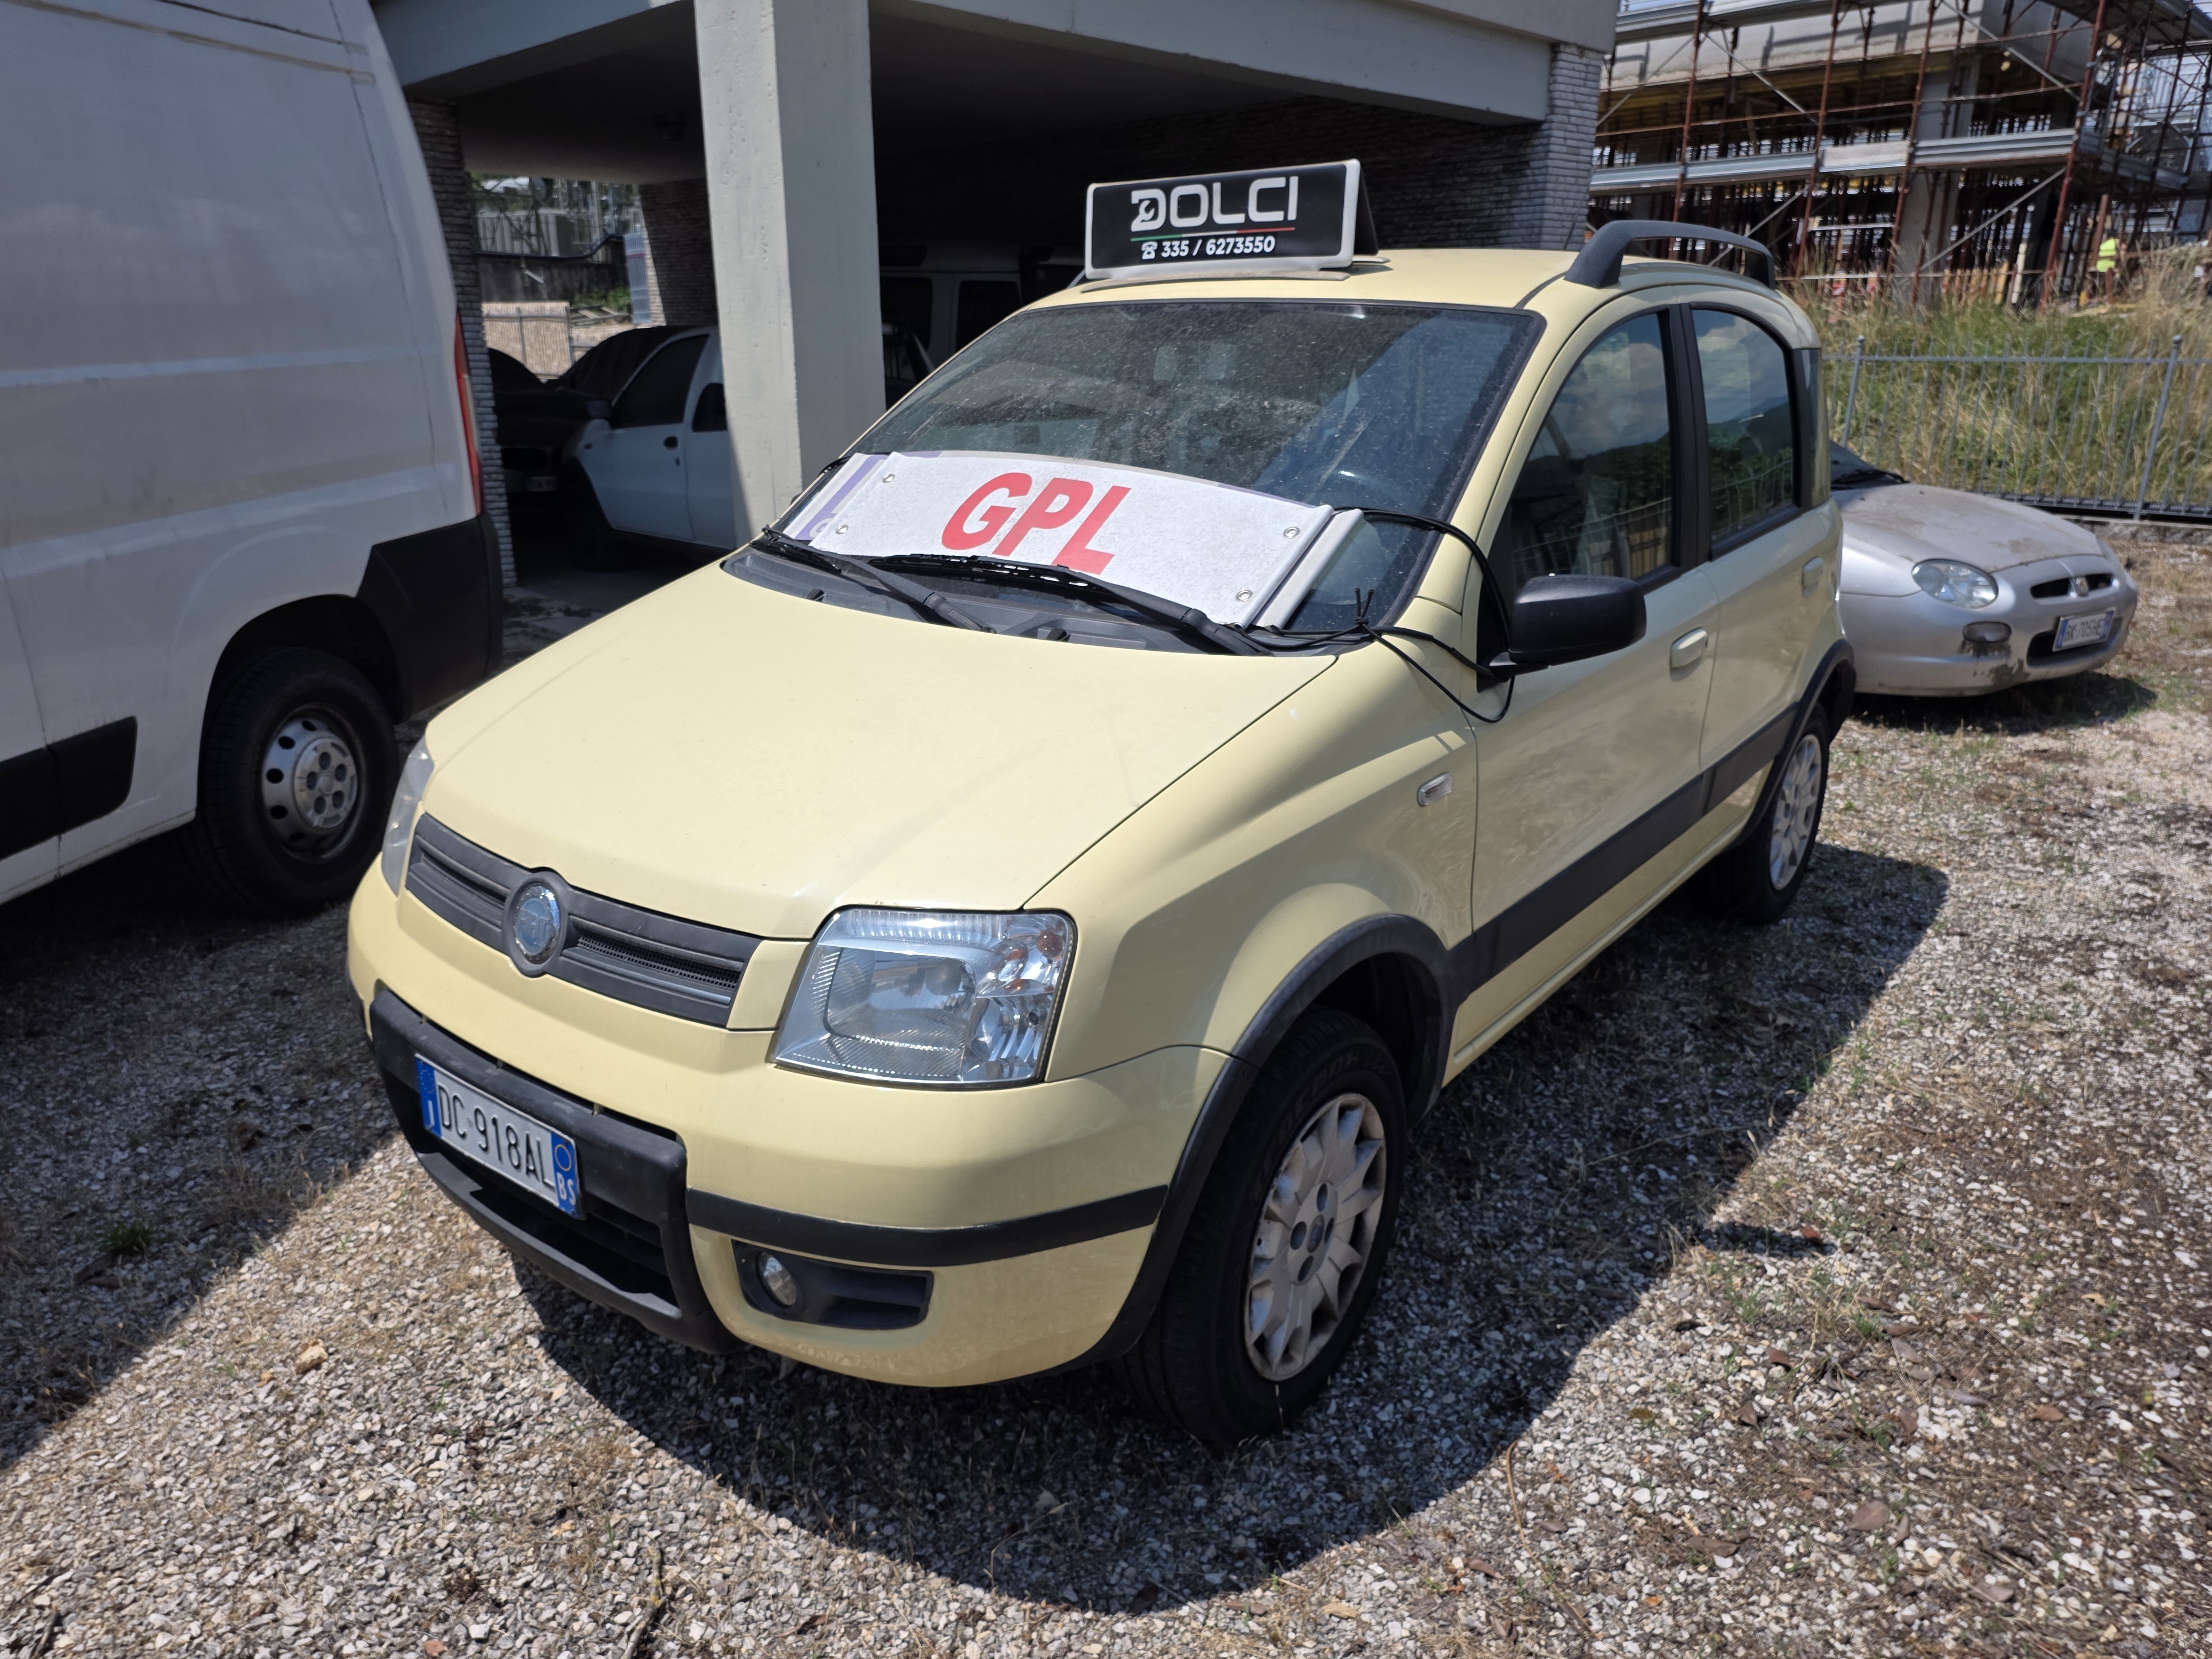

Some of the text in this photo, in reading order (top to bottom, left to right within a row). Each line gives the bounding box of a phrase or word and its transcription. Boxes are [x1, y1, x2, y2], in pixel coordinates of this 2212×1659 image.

[1131, 176, 1298, 232] DOLCI
[1161, 236, 1276, 258] 335 / 6273550
[941, 472, 1132, 576] GPL
[437, 1082, 556, 1190] DC 918AL
[556, 1172, 576, 1206] BS
